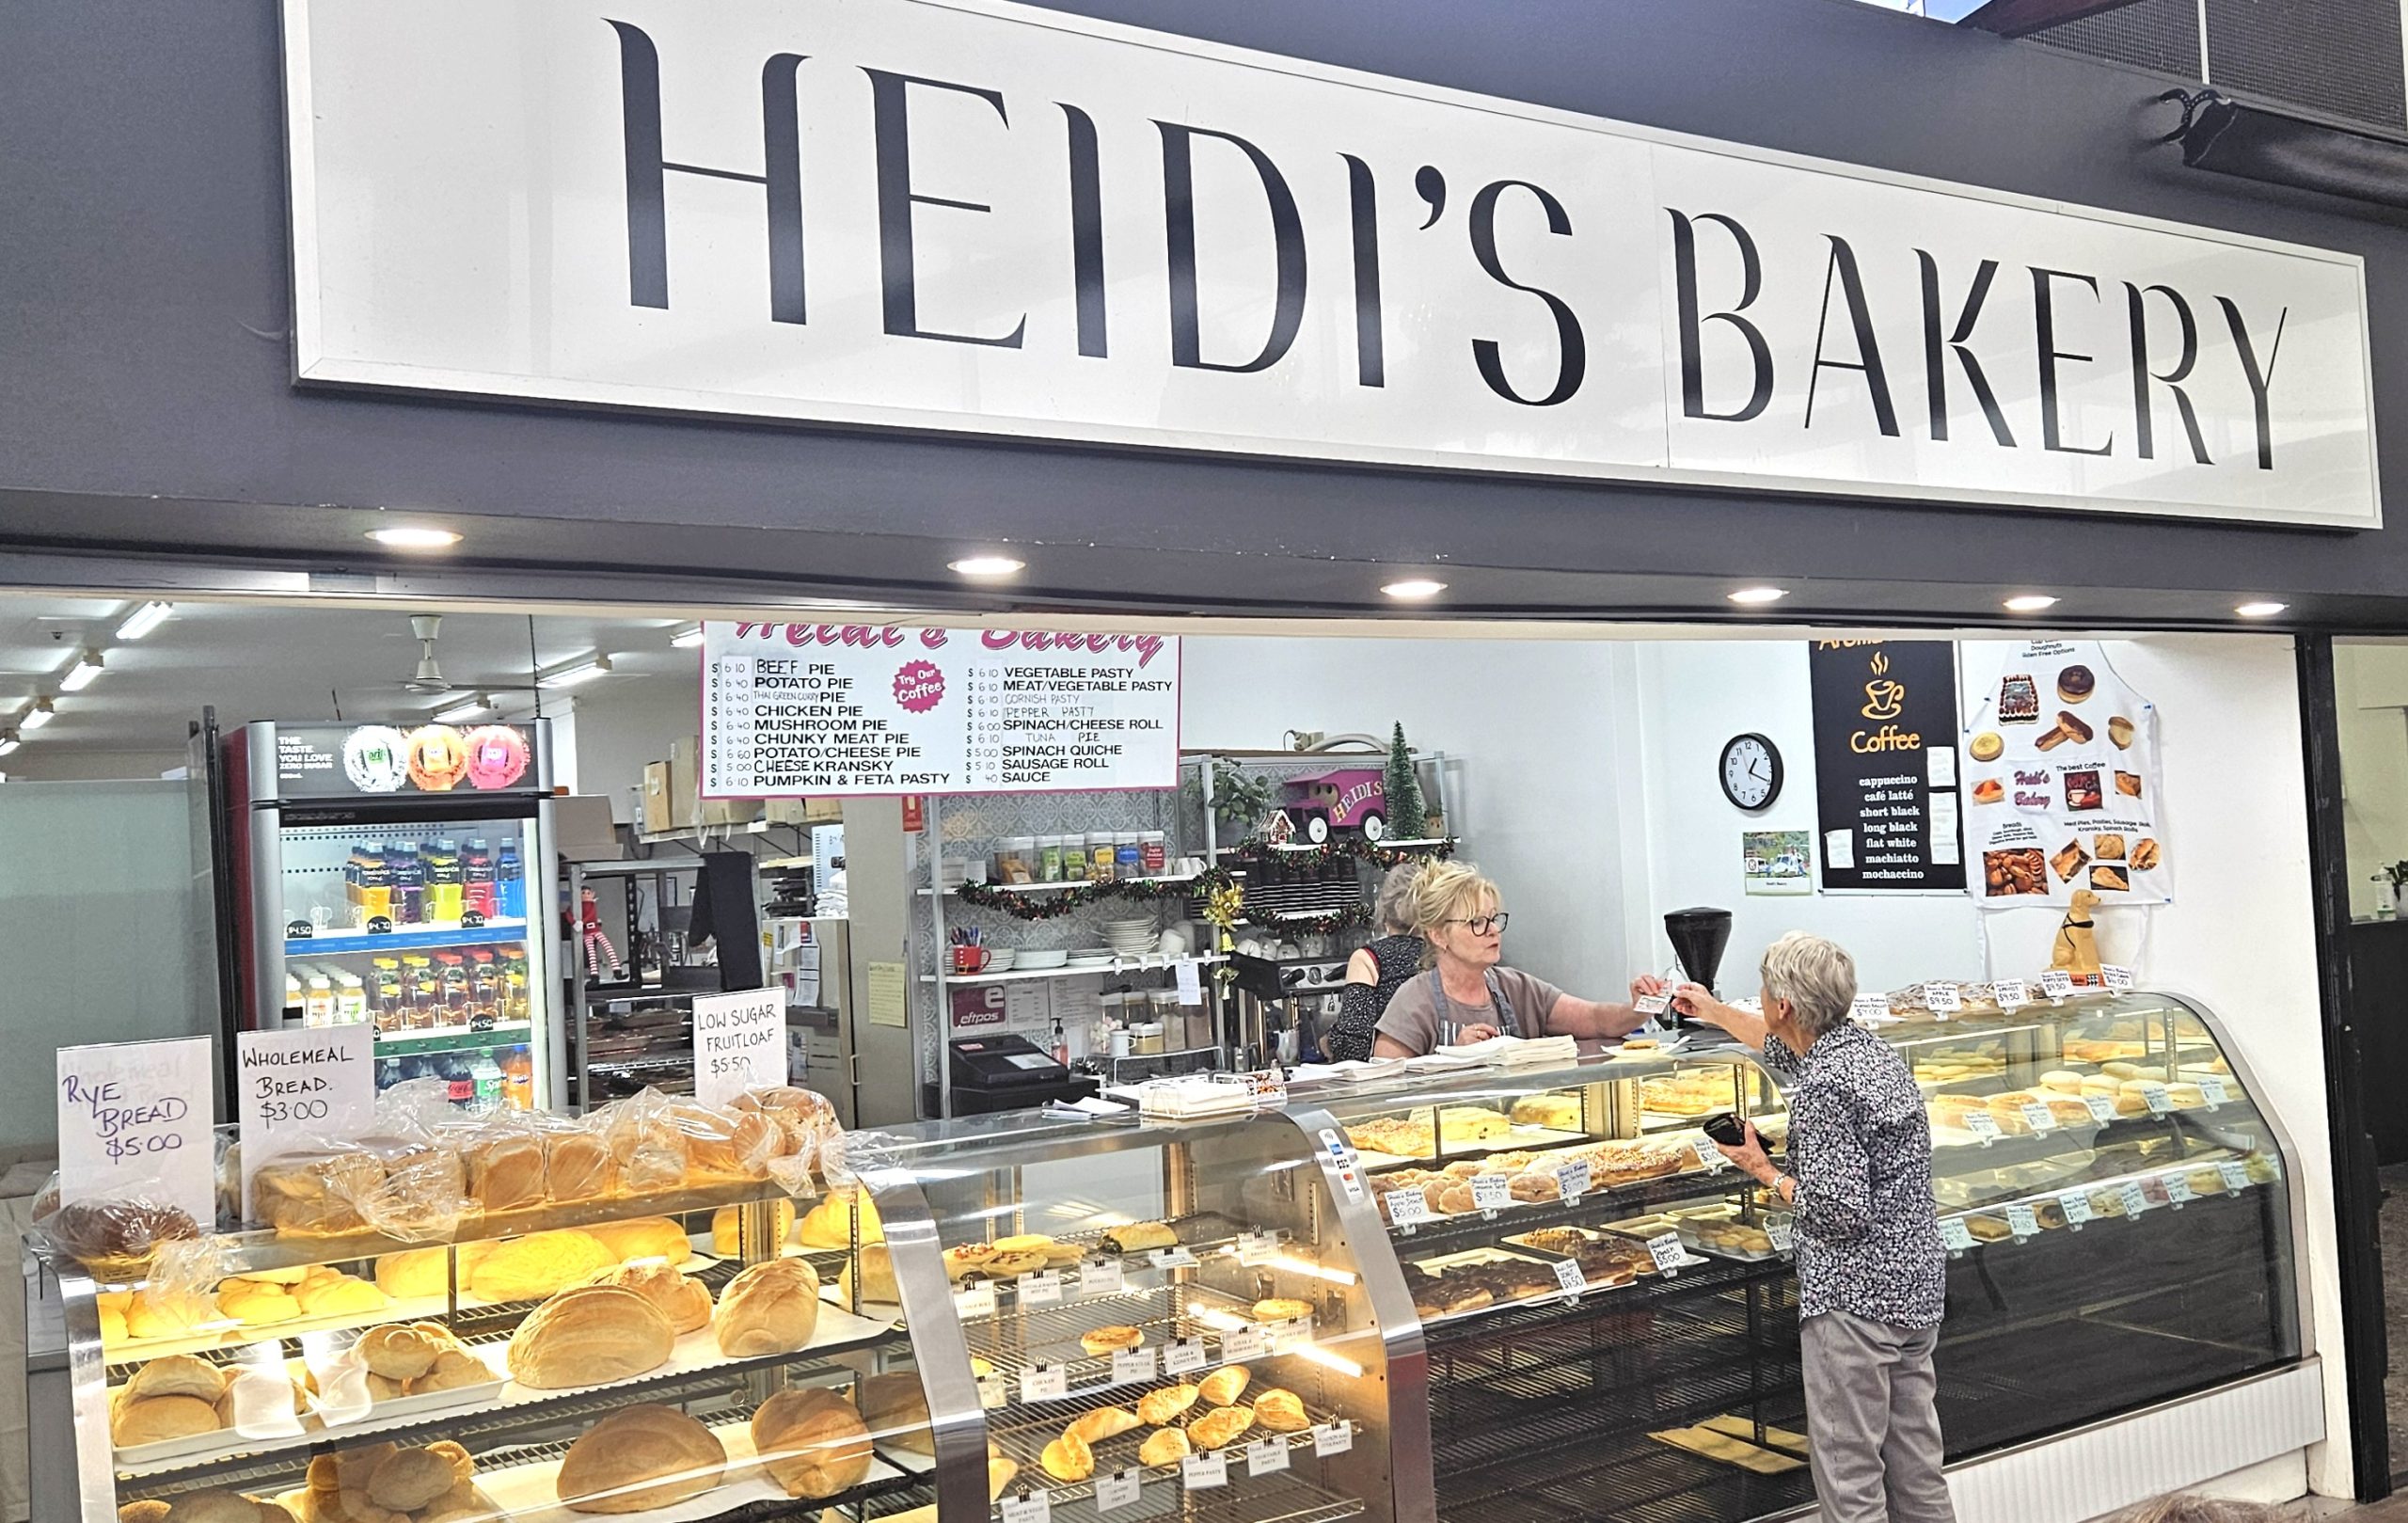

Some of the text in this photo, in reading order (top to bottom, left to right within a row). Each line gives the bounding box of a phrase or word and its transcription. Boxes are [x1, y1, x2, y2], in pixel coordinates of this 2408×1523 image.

[603, 19, 2288, 470] HEIDI'S BAKERY
[756, 658, 799, 674] BEEF
[808, 664, 835, 675] PIE
[1004, 667, 1086, 678] VEGETABLE
[1091, 668, 1134, 678] PASTY
[754, 676, 821, 689] POTATO
[828, 677, 854, 689] PIE
[897, 669, 936, 686] Try Our
[1003, 680, 1127, 691] MEAT/VEGETABLE
[1132, 681, 1172, 691] PASTY
[753, 690, 771, 700] THAI
[772, 690, 797, 701] GREEN
[820, 692, 846, 703] PIE
[898, 682, 943, 702] Coffee
[1005, 693, 1047, 705] CORNISH
[1051, 694, 1080, 705] PASTY
[754, 705, 832, 717] CHICKEN
[837, 706, 863, 717] PIE
[1006, 707, 1050, 719] PEPPER
[1061, 706, 1095, 717] PASTY
[754, 720, 857, 731] MUSHROOM
[863, 720, 888, 731] PIE
[1003, 719, 1125, 731] SPINACH/CHEESE
[1129, 719, 1164, 730] ROLL
[277, 736, 302, 745] THE
[754, 733, 827, 745] CHUNKY
[833, 733, 879, 744] MEAT
[884, 733, 910, 744] PIE
[1025, 733, 1056, 743] TUNA
[1078, 732, 1101, 743] PIE
[1850, 724, 1921, 754] Coffee
[277, 745, 315, 754] TASTE
[1002, 745, 1066, 756] SPINACH
[1069, 744, 1122, 755] QUICHE
[1735, 747, 1743, 756] 11
[1745, 740, 1752, 751] 12
[278, 754, 333, 763] YOU LOVE
[753, 747, 891, 758] POTATO/CHEESE
[896, 747, 921, 757] PIE
[1764, 752, 1769, 760] 2
[753, 759, 811, 773] CHEESE
[814, 760, 894, 772] KRANSKY
[1002, 758, 1069, 770] SAUSAGE
[1073, 758, 1109, 769] ROLL
[1730, 757, 1738, 766] 10
[753, 774, 832, 786] PUMPKIN
[837, 774, 848, 785] &
[854, 773, 895, 785] FETA
[900, 772, 950, 785] PASTY
[1002, 771, 1051, 783] SAUCE
[1859, 774, 1918, 789] cappuccino
[1733, 783, 1738, 791] 8
[1741, 791, 1747, 800] 7
[1751, 793, 1757, 802] 6
[1760, 789, 1766, 798] 5
[1864, 789, 1914, 802] café latté
[1860, 805, 1921, 818] short black
[1862, 821, 1919, 835] long black
[1865, 837, 1917, 849] flat white
[1865, 853, 1920, 865] machiatto
[1861, 868, 1925, 880] mochaccino
[288, 926, 312, 936] $4.50
[698, 1004, 777, 1032] LOW SUGAR
[960, 1011, 999, 1024] eftpos
[706, 1028, 775, 1053] FRUITLOAF
[242, 1045, 355, 1069] WHOLEMEAL
[94, 1097, 188, 1138] BREAD
